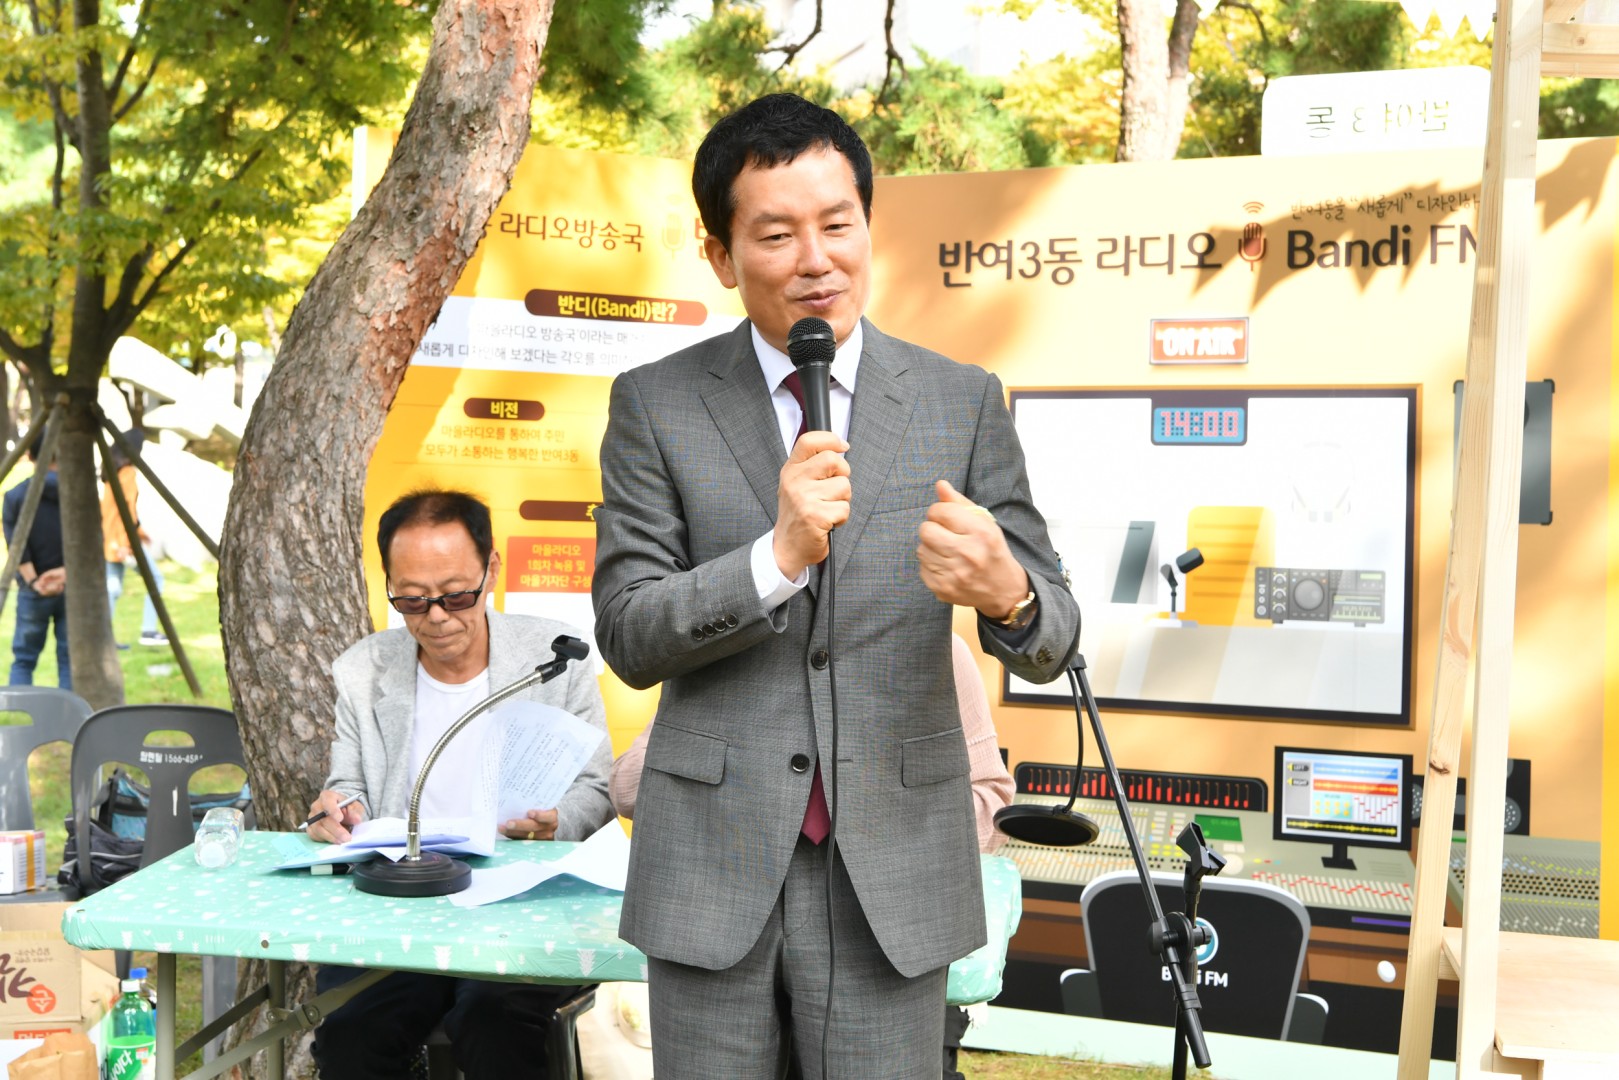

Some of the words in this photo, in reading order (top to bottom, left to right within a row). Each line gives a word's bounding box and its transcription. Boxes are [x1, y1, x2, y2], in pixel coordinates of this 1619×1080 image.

[500, 212, 645, 253] 라디오방송국
[938, 237, 1083, 288] 반여3동
[1096, 232, 1223, 277] 라디오
[1287, 224, 1412, 270] Bandi
[557, 294, 677, 322] 반디(Bandi)란?
[1162, 327, 1195, 356] ON
[1196, 326, 1236, 356] AIR
[490, 401, 519, 419] 비전
[1160, 411, 1239, 437] 14:00
[532, 543, 582, 557] 마을라디오
[1205, 970, 1229, 988] FM
